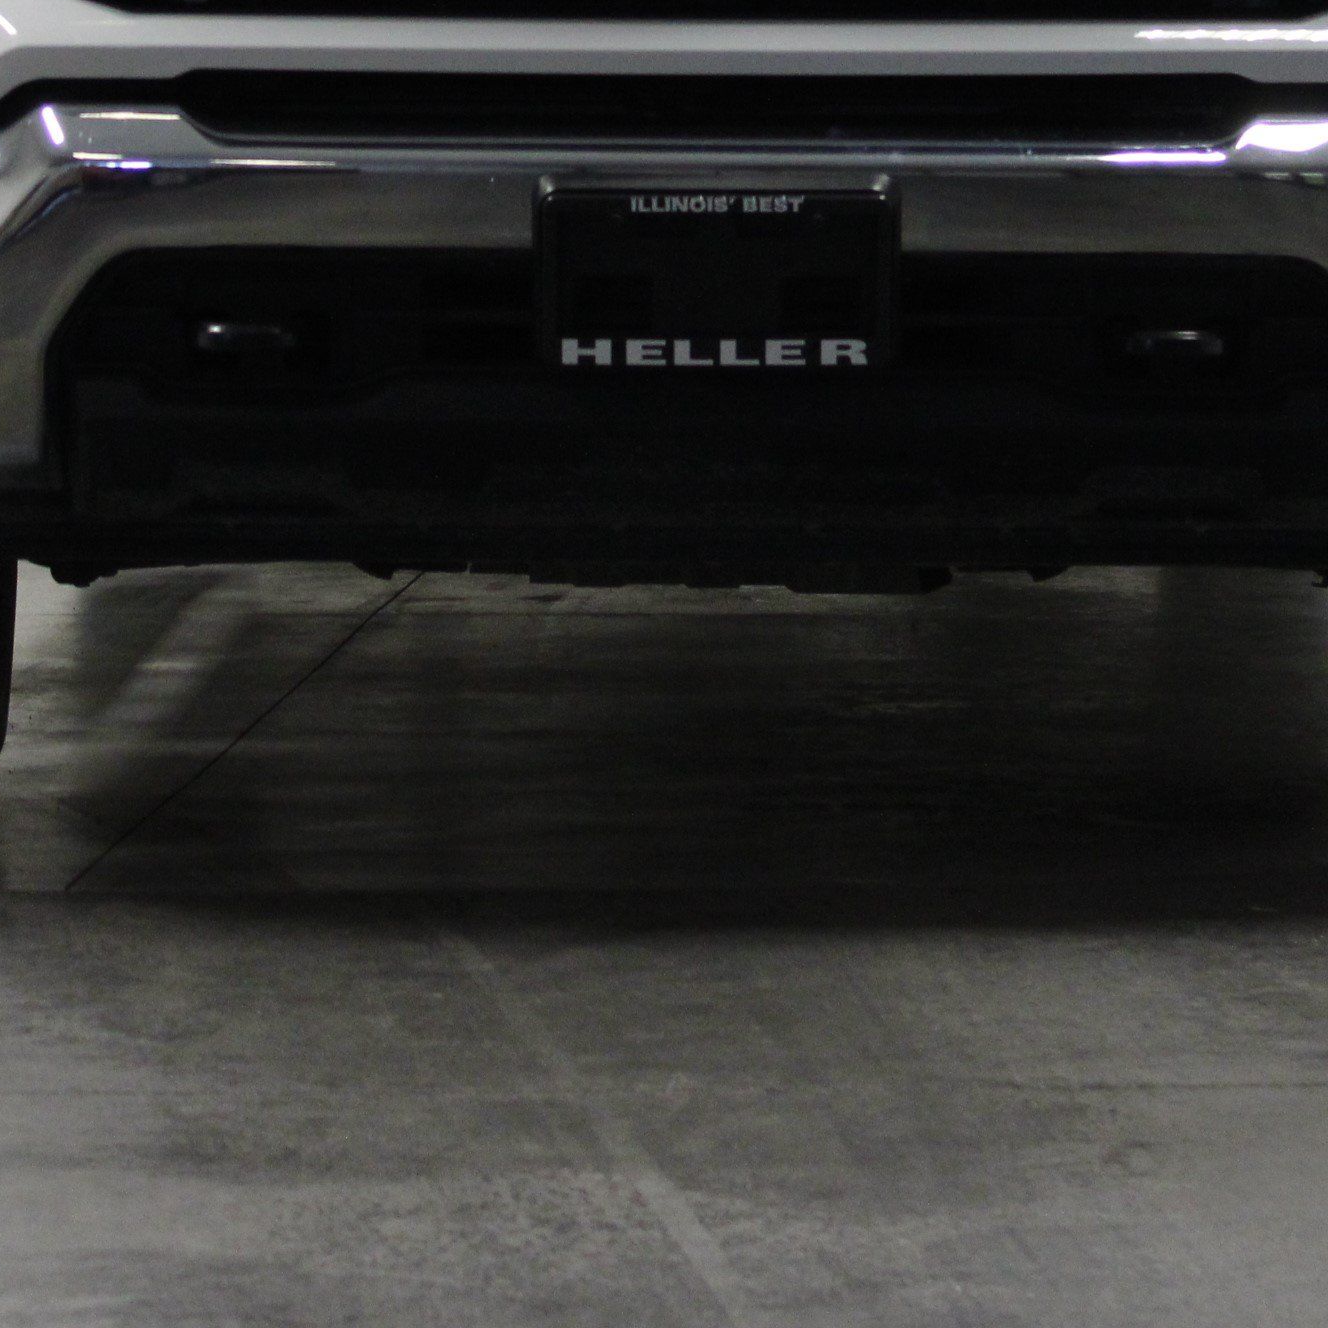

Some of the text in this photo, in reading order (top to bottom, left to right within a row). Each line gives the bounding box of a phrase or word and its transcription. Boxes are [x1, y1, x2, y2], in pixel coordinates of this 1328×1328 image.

[630, 194, 805, 213] ILLINOIS' BEST
[560, 338, 869, 366] HELLER
